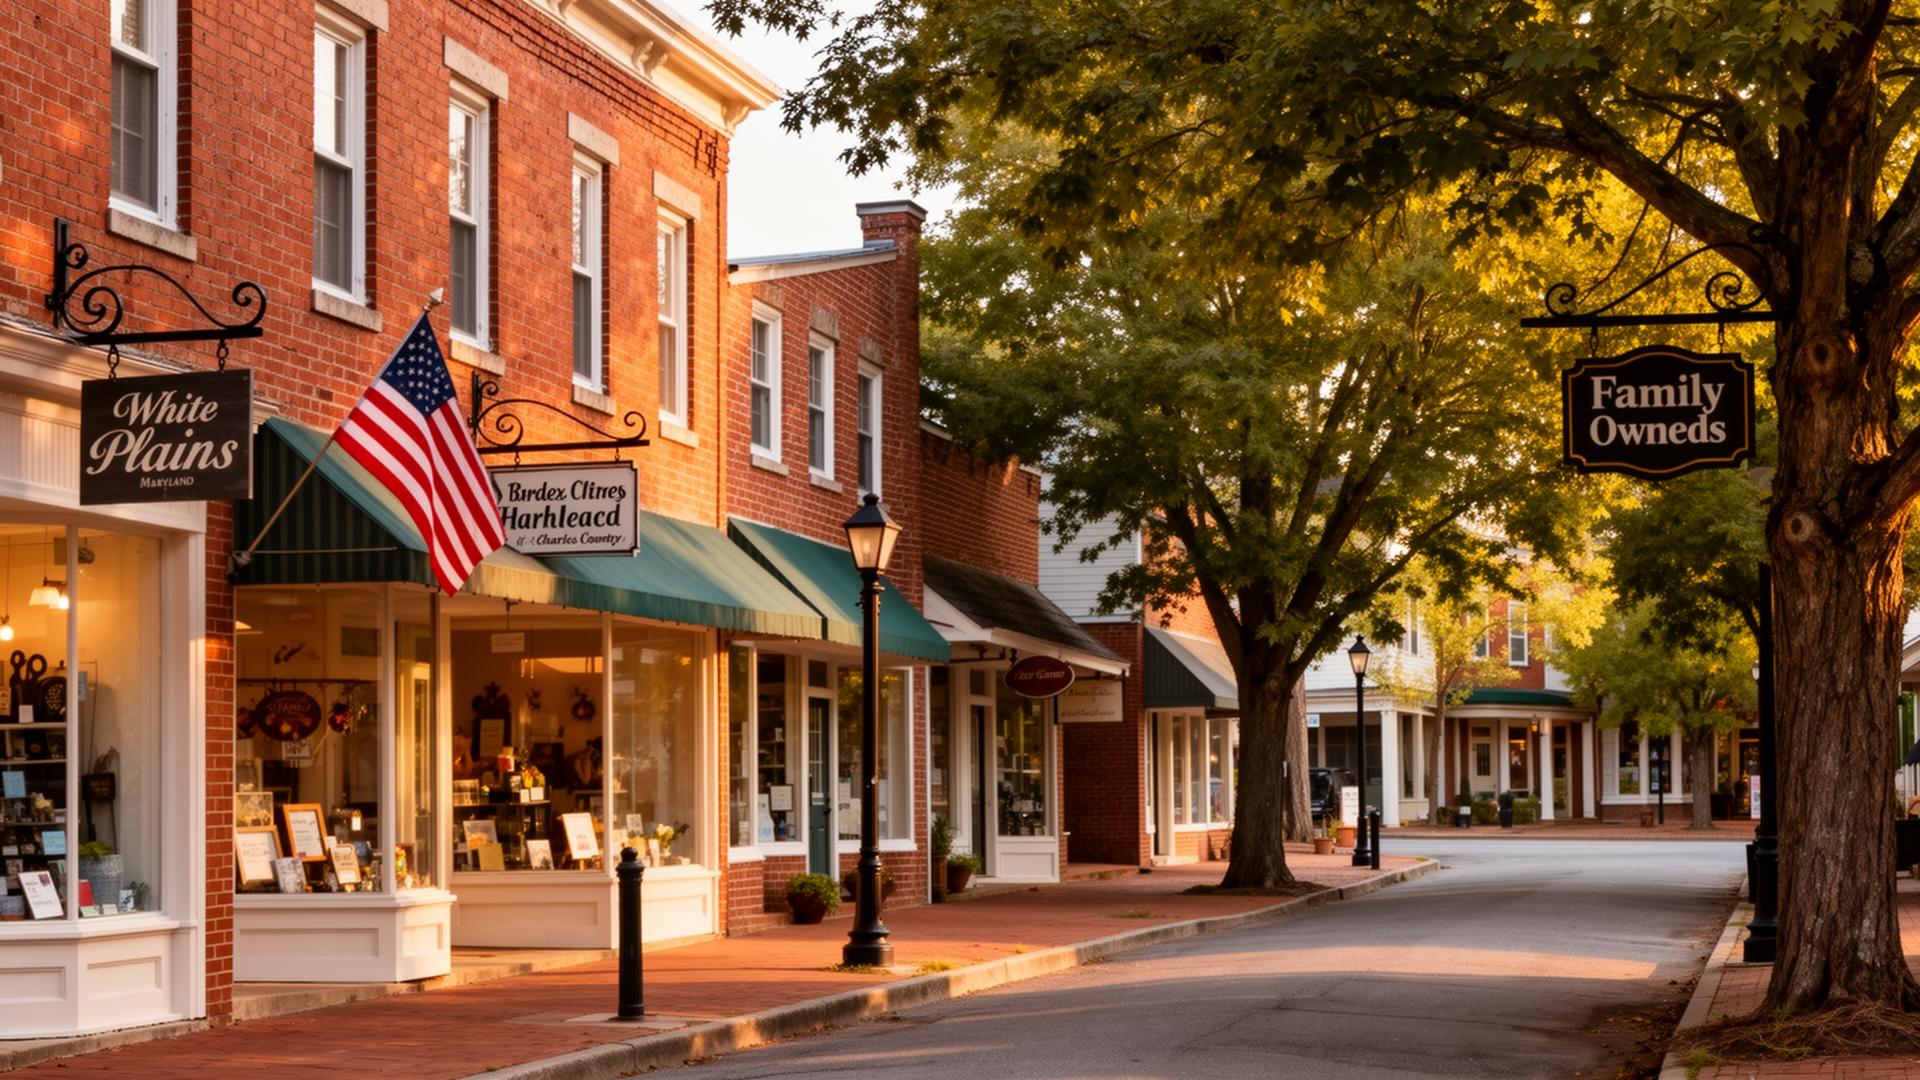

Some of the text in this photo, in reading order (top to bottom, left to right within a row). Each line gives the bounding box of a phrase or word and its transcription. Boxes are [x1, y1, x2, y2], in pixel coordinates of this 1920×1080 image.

[112, 390, 218, 426] White
[1590, 372, 1725, 414] Family
[1589, 414, 1726, 446] Owneds
[86, 426, 239, 475] Plains
[140, 476, 194, 488] MARYLAND
